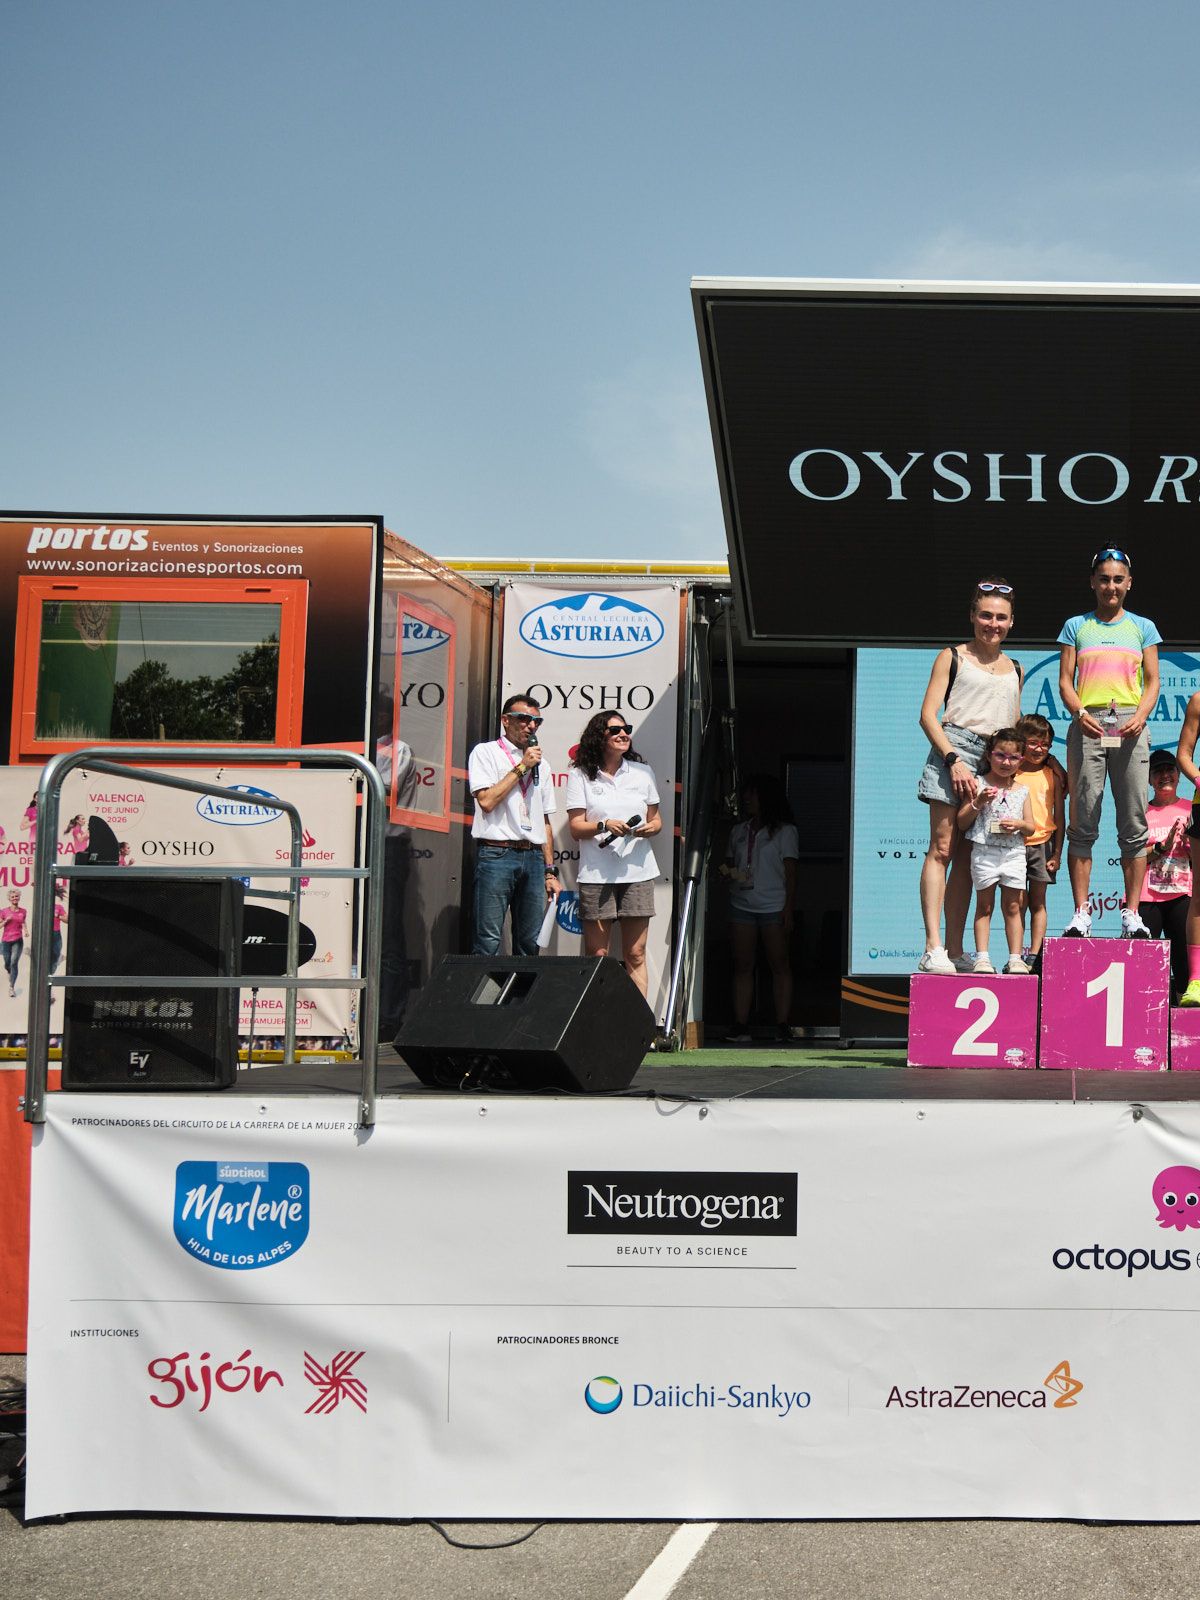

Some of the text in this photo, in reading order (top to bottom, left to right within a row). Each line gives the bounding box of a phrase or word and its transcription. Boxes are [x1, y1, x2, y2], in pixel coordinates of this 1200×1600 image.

[788, 448, 1130, 505] OYSHO
[27, 525, 304, 554] portos Eventos y Sonorizaciones
[27, 558, 303, 576] www.sonorizacionesportos.com
[530, 616, 653, 641] ASTURIANA
[525, 683, 655, 711] OYSHO
[89, 793, 145, 803] VALENCIA
[141, 840, 214, 857] OYSHO
[275, 849, 335, 861] Saander
[1086, 962, 1125, 1047] 1
[952, 987, 999, 1056] 2
[72, 1117, 151, 1128] PATROCINADORES
[153, 1119, 170, 1128] DEL
[172, 1119, 214, 1129] CIRCUITO
[216, 1120, 228, 1129] DE
[230, 1120, 241, 1129] LA
[244, 1121, 285, 1130] CARRERA
[287, 1121, 299, 1130] DE
[301, 1121, 313, 1130] LA
[315, 1121, 345, 1130] MUJER
[187, 1237, 293, 1265] HIJA DE LOS ALPES
[616, 1246, 748, 1256] BEAUTY TO A SCIENCE
[1052, 1243, 1191, 1278] octopus
[70, 1328, 139, 1338] INSTITUCIONES
[497, 1335, 620, 1345] PATROCINADORES BRONCE
[633, 1383, 811, 1417] Daiichi-Sankyo
[885, 1385, 1047, 1409] AstraZeneca
